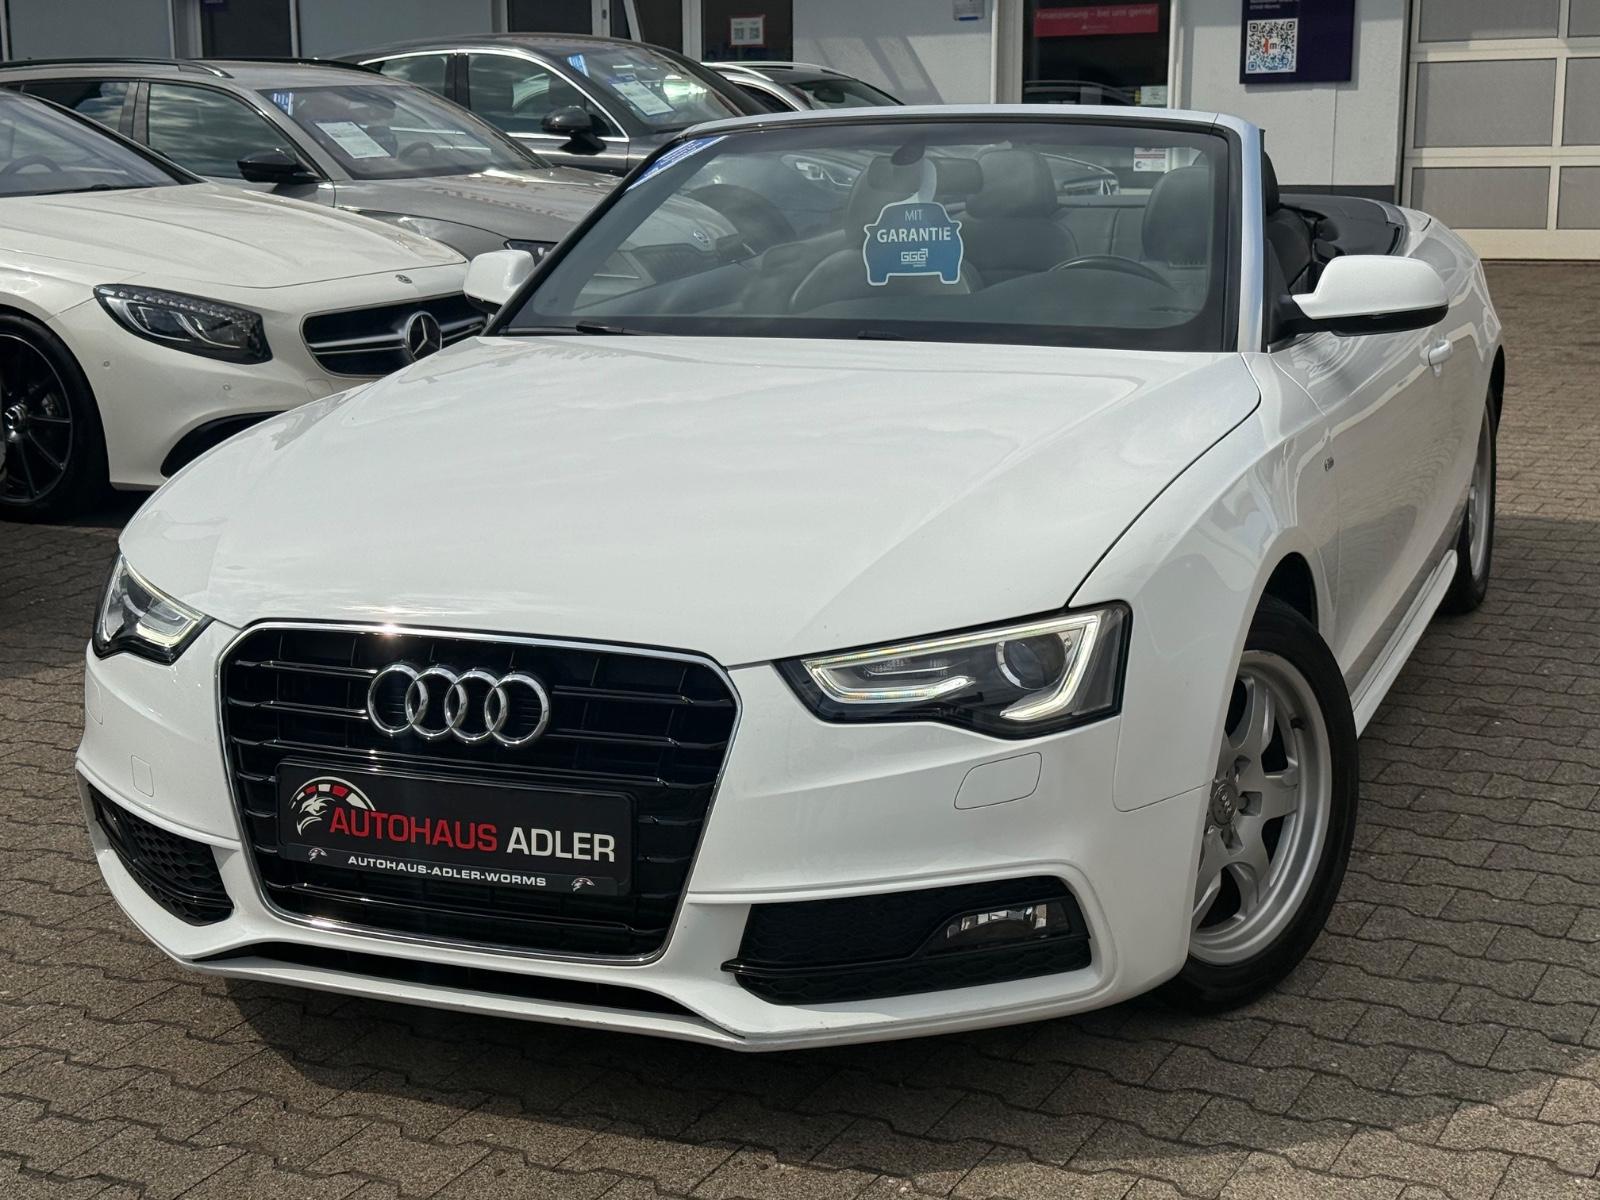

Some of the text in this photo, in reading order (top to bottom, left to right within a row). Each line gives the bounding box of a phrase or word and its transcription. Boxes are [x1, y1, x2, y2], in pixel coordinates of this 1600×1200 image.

[905, 209, 923, 221] MIT
[877, 227, 951, 243] GARANTIE
[329, 807, 616, 863] AUTOHAUS ADLER
[347, 855, 547, 887] AUTOHAUS-ADLER-WORMS
